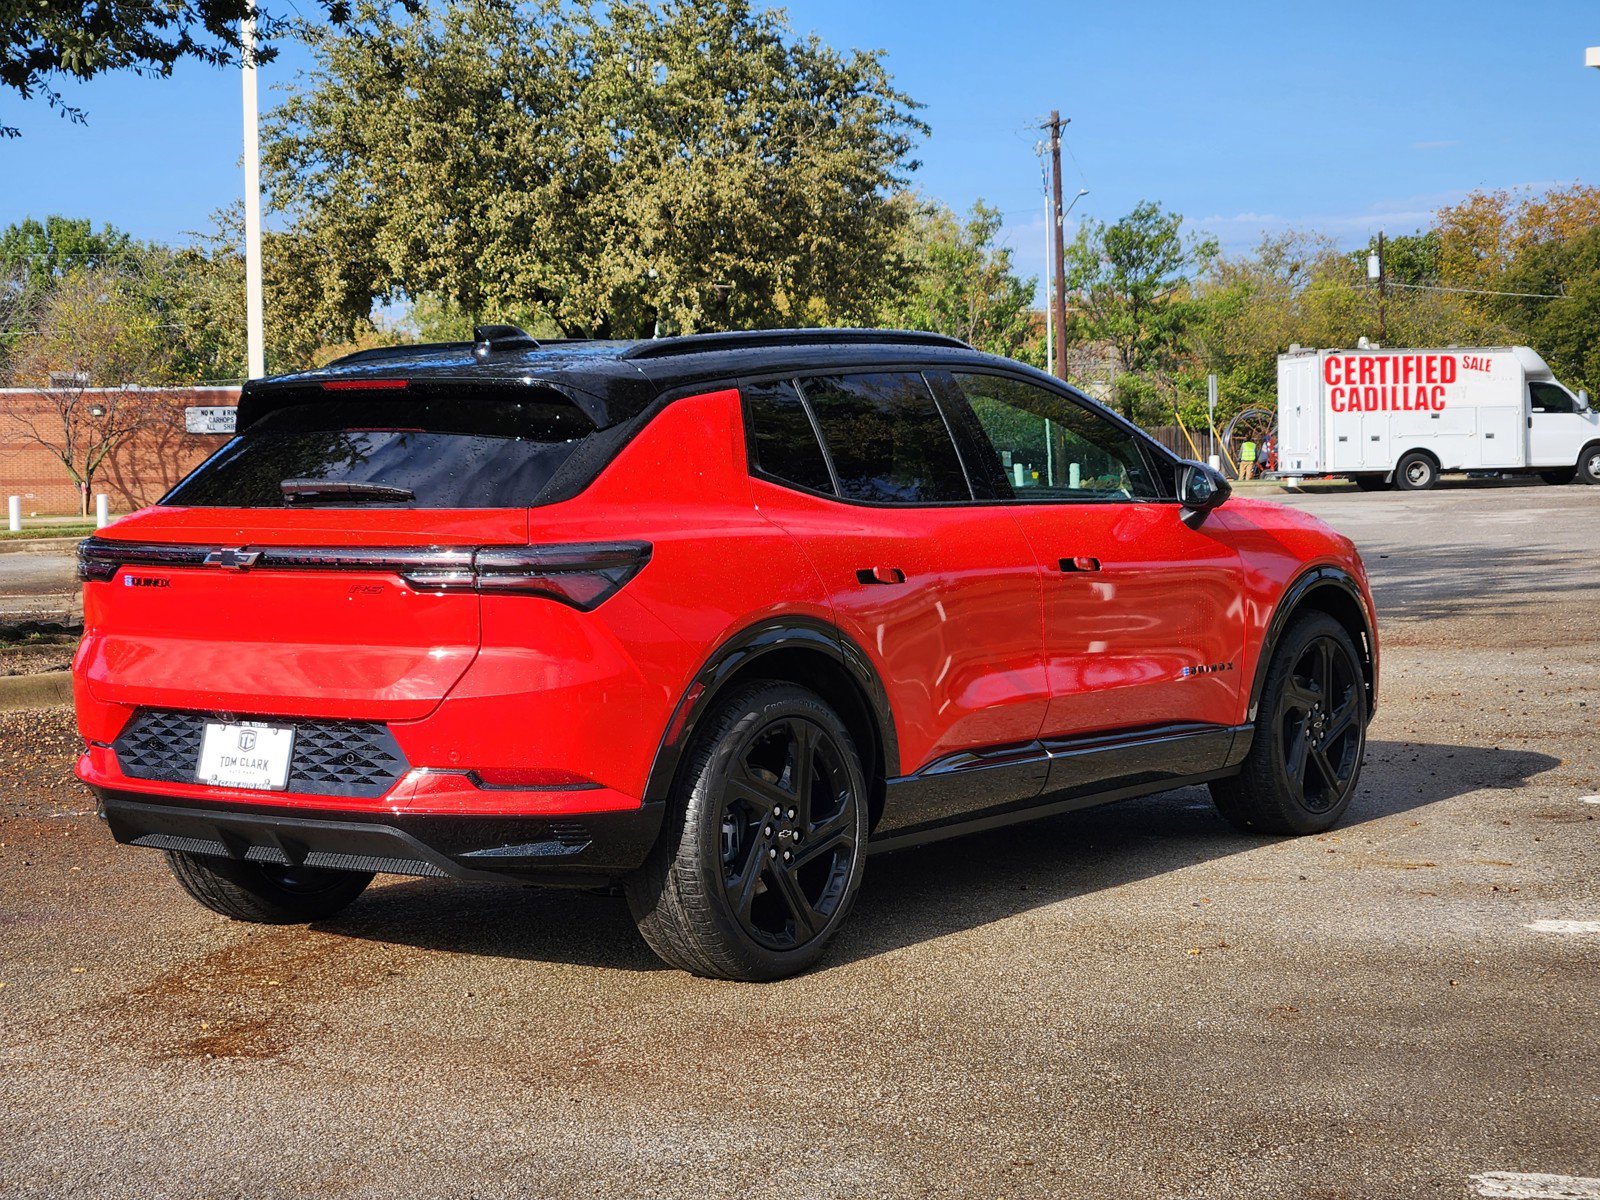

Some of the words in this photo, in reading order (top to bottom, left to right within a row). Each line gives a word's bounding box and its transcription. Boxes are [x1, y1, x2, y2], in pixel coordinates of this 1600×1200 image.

[1325, 356, 1456, 385] CERTIFIED
[1462, 356, 1492, 373] SALE
[1331, 386, 1446, 412] CADILLAC
[220, 756, 237, 767] TOM
[239, 757, 269, 771] CLARK
